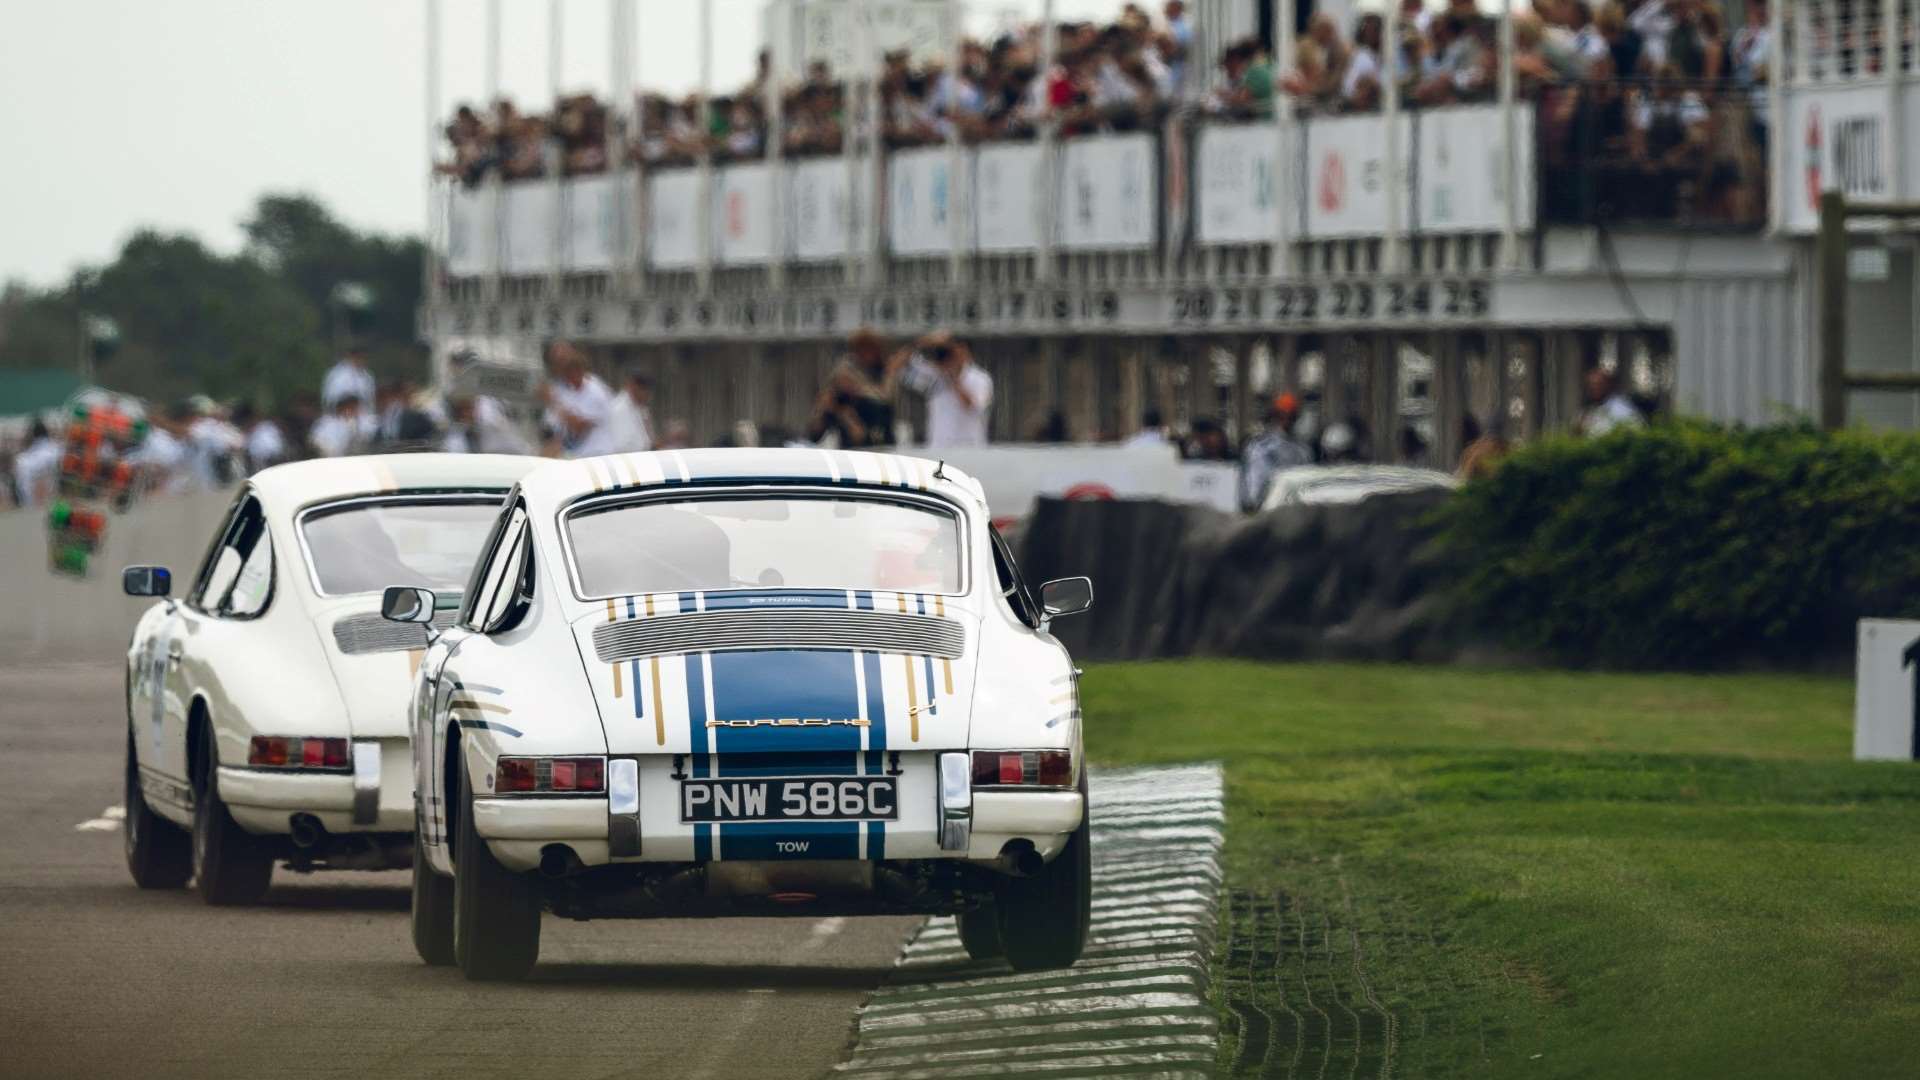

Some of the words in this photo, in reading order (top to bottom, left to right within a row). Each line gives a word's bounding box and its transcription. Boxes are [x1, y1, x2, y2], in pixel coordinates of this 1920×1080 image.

[1274, 284, 1318, 318] 22
[1331, 281, 1374, 317] 23
[1388, 281, 1431, 314] 24
[1444, 278, 1489, 315] 25
[705, 718, 872, 728] PORSCHE
[684, 783, 768, 818] PNW
[781, 781, 893, 816] 586C
[775, 841, 810, 853] TOW
